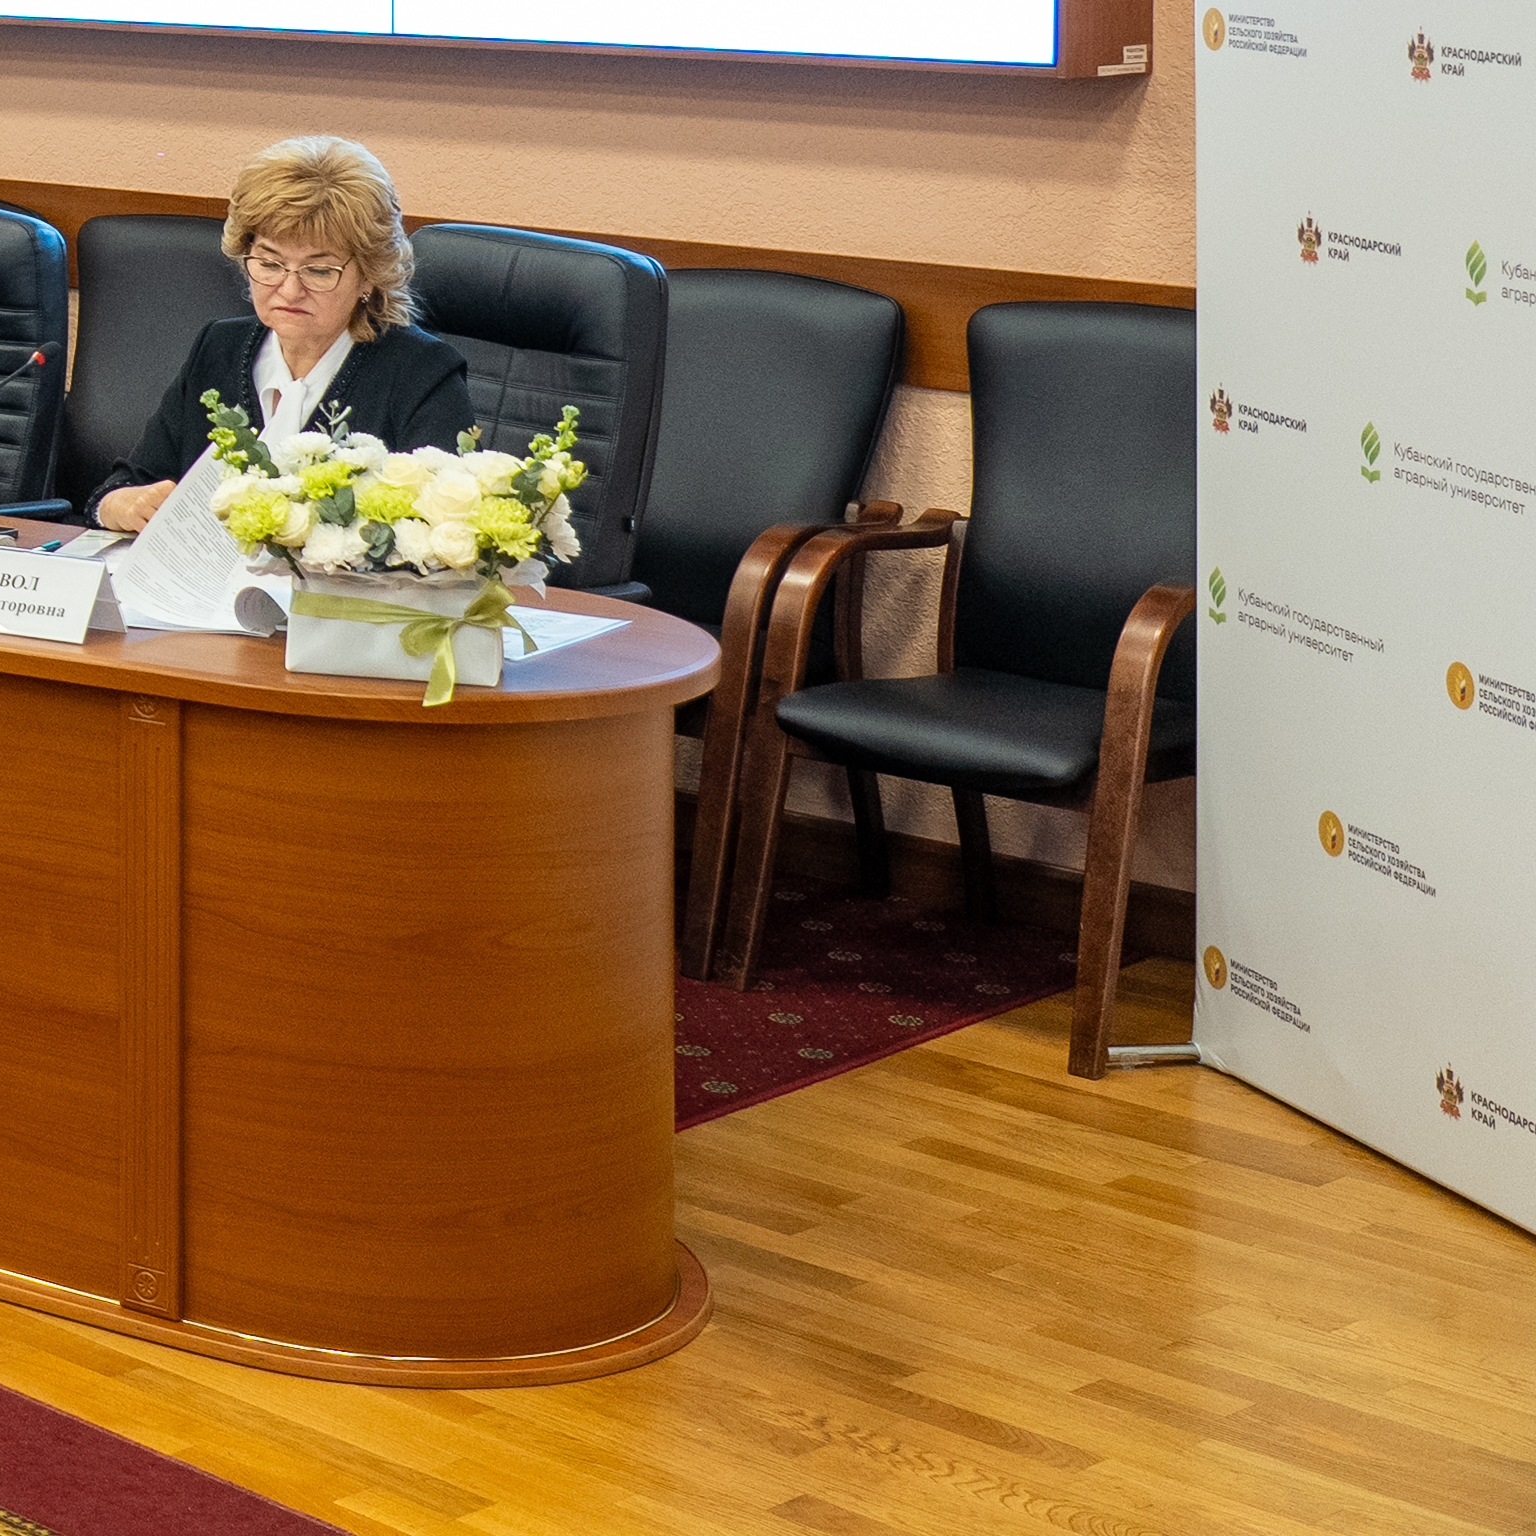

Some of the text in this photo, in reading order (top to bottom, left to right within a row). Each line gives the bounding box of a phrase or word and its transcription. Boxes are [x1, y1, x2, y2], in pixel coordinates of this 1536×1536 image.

[1228, 14, 1275, 27] МИНИСТЕРСТВО
[1228, 27, 1298, 43] СЕЛЬСКОГО ХОЗЯЙСТВА
[1228, 39, 1307, 58] РОССИЙСКОЙ ФЕДЕРАЦИИ
[1441, 46, 1522, 66] КРАСНОДАРСКИЙ
[1441, 63, 1464, 76] КРАЙ
[1328, 232, 1402, 256] КРАСНОДАРСКИЙ
[1328, 248, 1350, 262] КРАЙ
[1238, 404, 1306, 432] КРАСНОДАРСКИЙ
[1238, 419, 1258, 434] КРАЙ
[1394, 442, 1453, 472] Кубанский
[1394, 467, 1526, 515] аграрный университет
[1238, 587, 1384, 653] Кубанский государственный
[1238, 611, 1354, 663] аграрный университет
[1479, 674, 1536, 703] МИНИСТЕРСТВО
[1479, 688, 1520, 712] СЕЛЬСКОГО
[1479, 701, 1527, 728] РОССИЙСКОЙ
[1348, 823, 1400, 854] МИНИСТЕРСТВО
[1348, 838, 1426, 880] СЕЛЬСКОГО ХОЗЯЙСТВА
[1348, 850, 1436, 898] РОССИЙСКОЙ ФЕДЕРАЦИИ
[1230, 958, 1278, 991] МИНИСТЕРСТВО
[1230, 972, 1301, 1016] СЕЛЬСКОГО ХОЗЯЙСТВА
[1230, 984, 1310, 1034] РОССИЙСКОЙ ФЕДЕРАЦИИ
[1471, 1090, 1536, 1135] КРАСНОДАРС
[1471, 1108, 1496, 1130] КРАЙ
